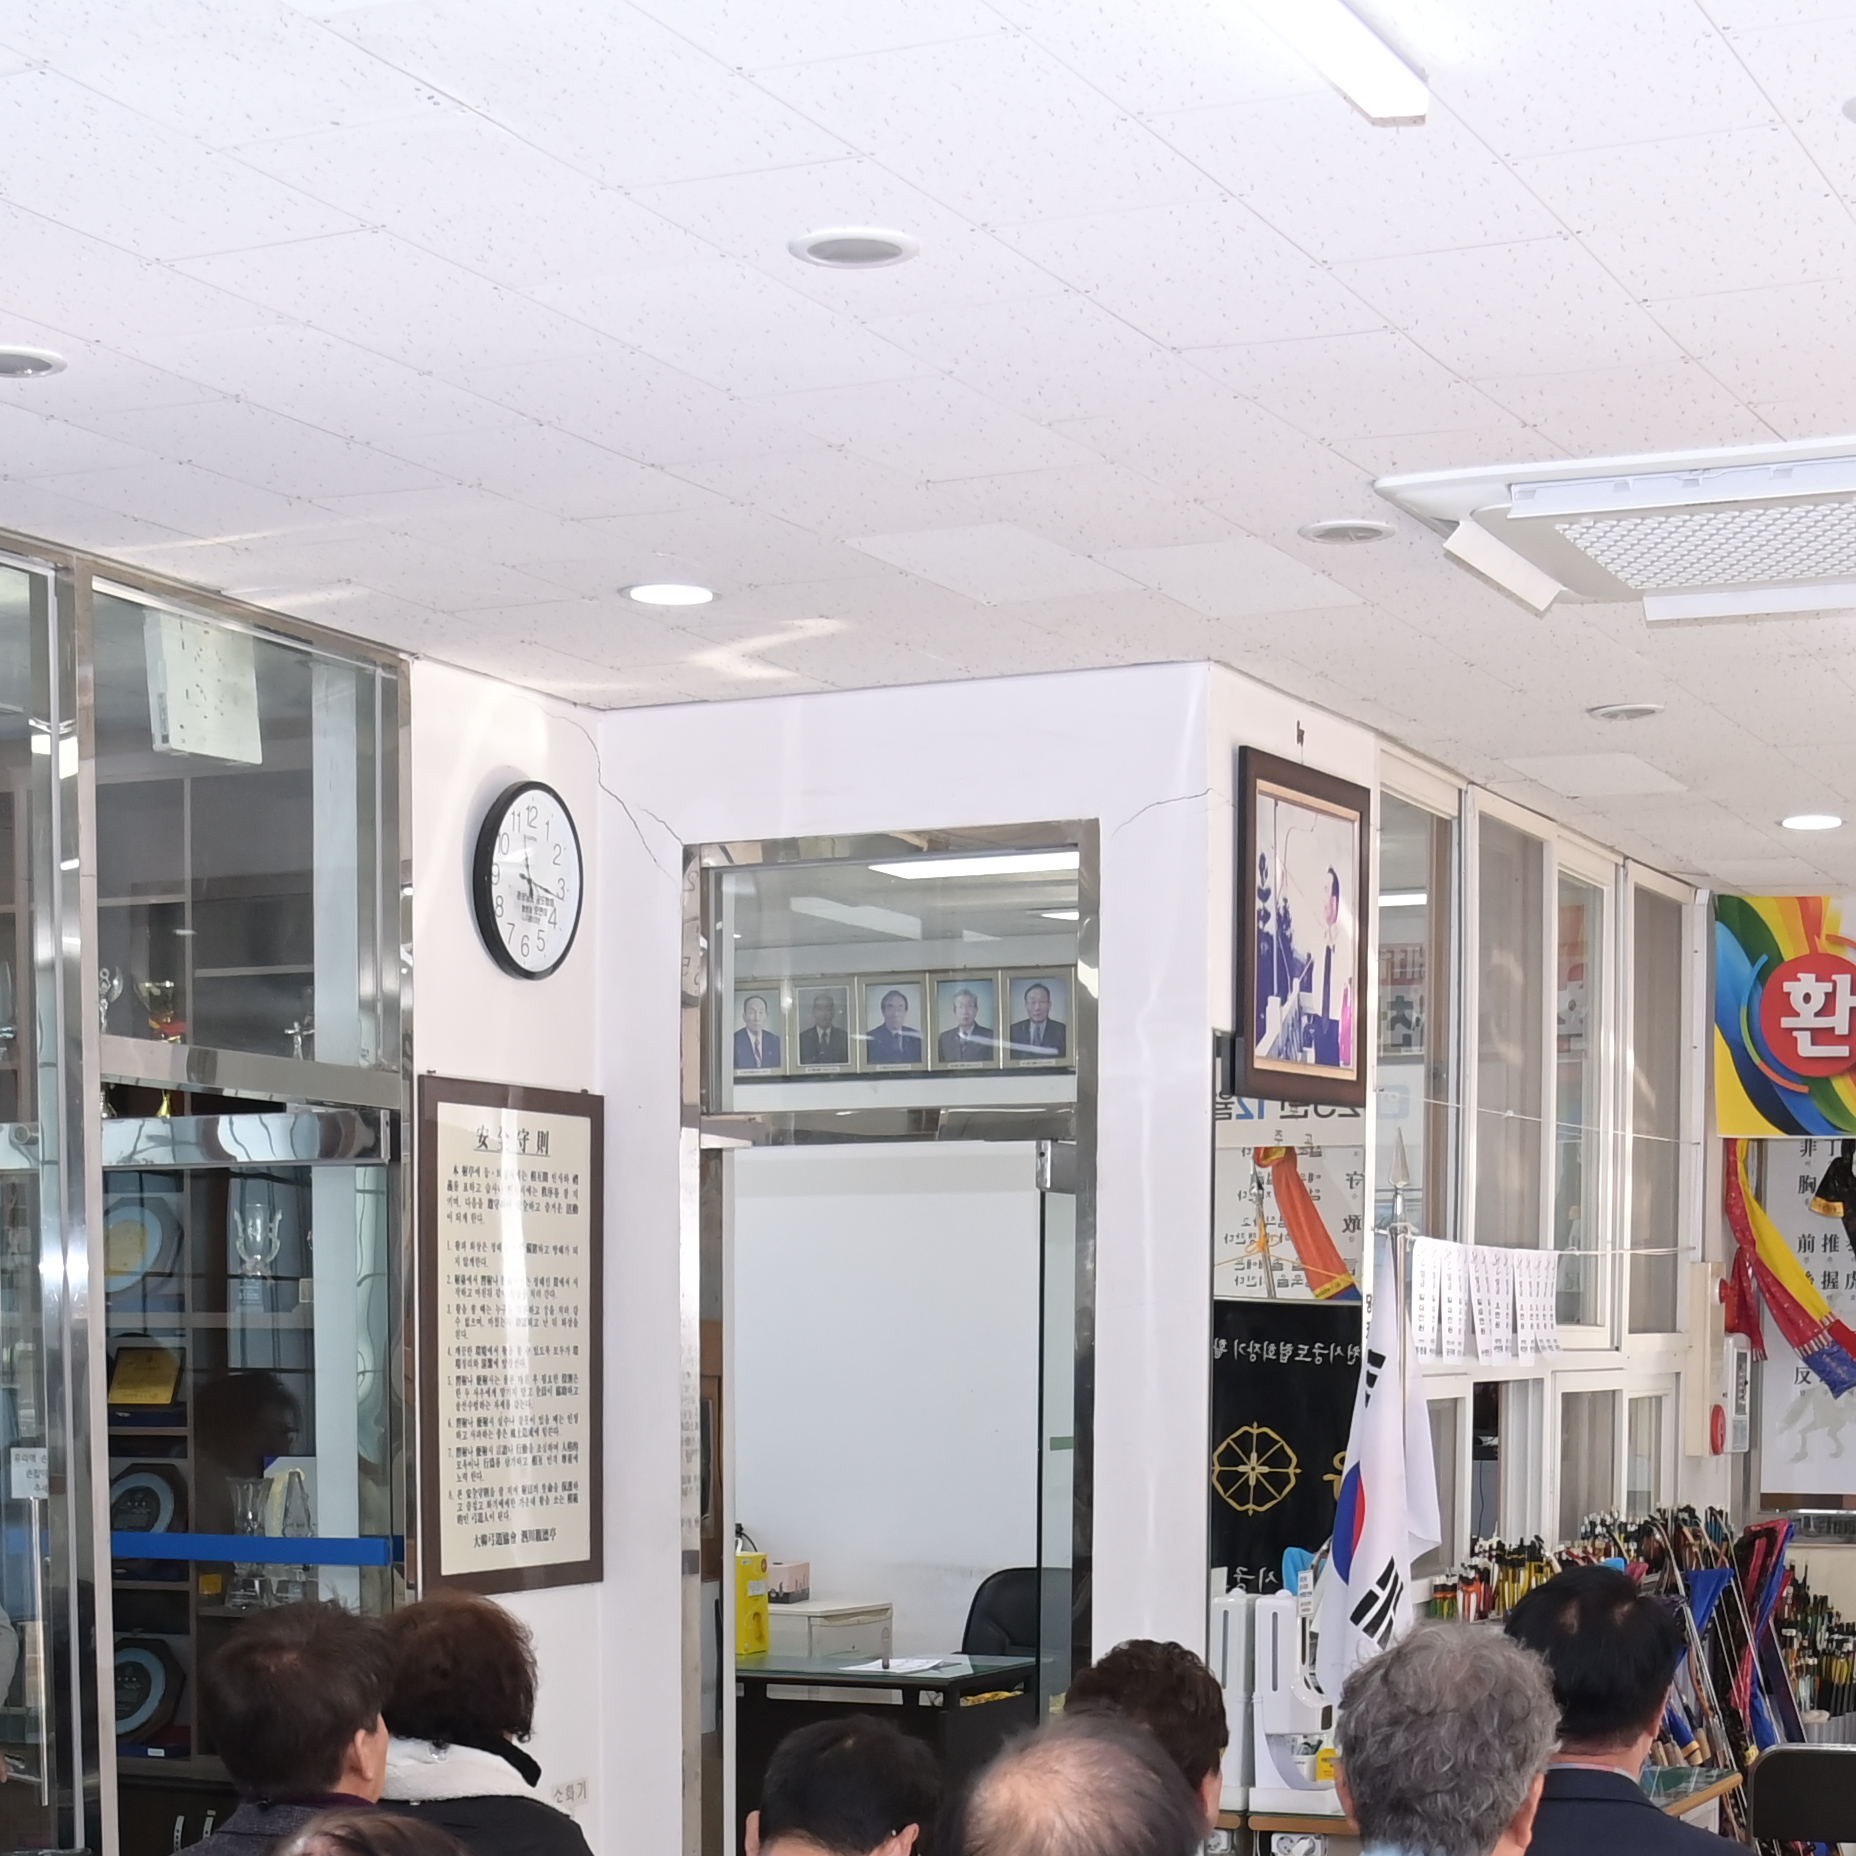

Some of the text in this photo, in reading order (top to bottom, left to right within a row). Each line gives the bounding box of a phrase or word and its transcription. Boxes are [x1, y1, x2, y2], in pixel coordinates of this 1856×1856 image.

[511, 811, 521, 833] 11
[526, 805, 539, 829] 12
[545, 820, 550, 841] 1
[552, 844, 562, 866] 2
[491, 863, 500, 885] 9
[557, 877, 566, 901] 3
[495, 895, 504, 918] 8
[548, 907, 558, 929] 4
[507, 922, 515, 945] 7
[537, 930, 545, 952] 5
[520, 934, 530, 957] 6
